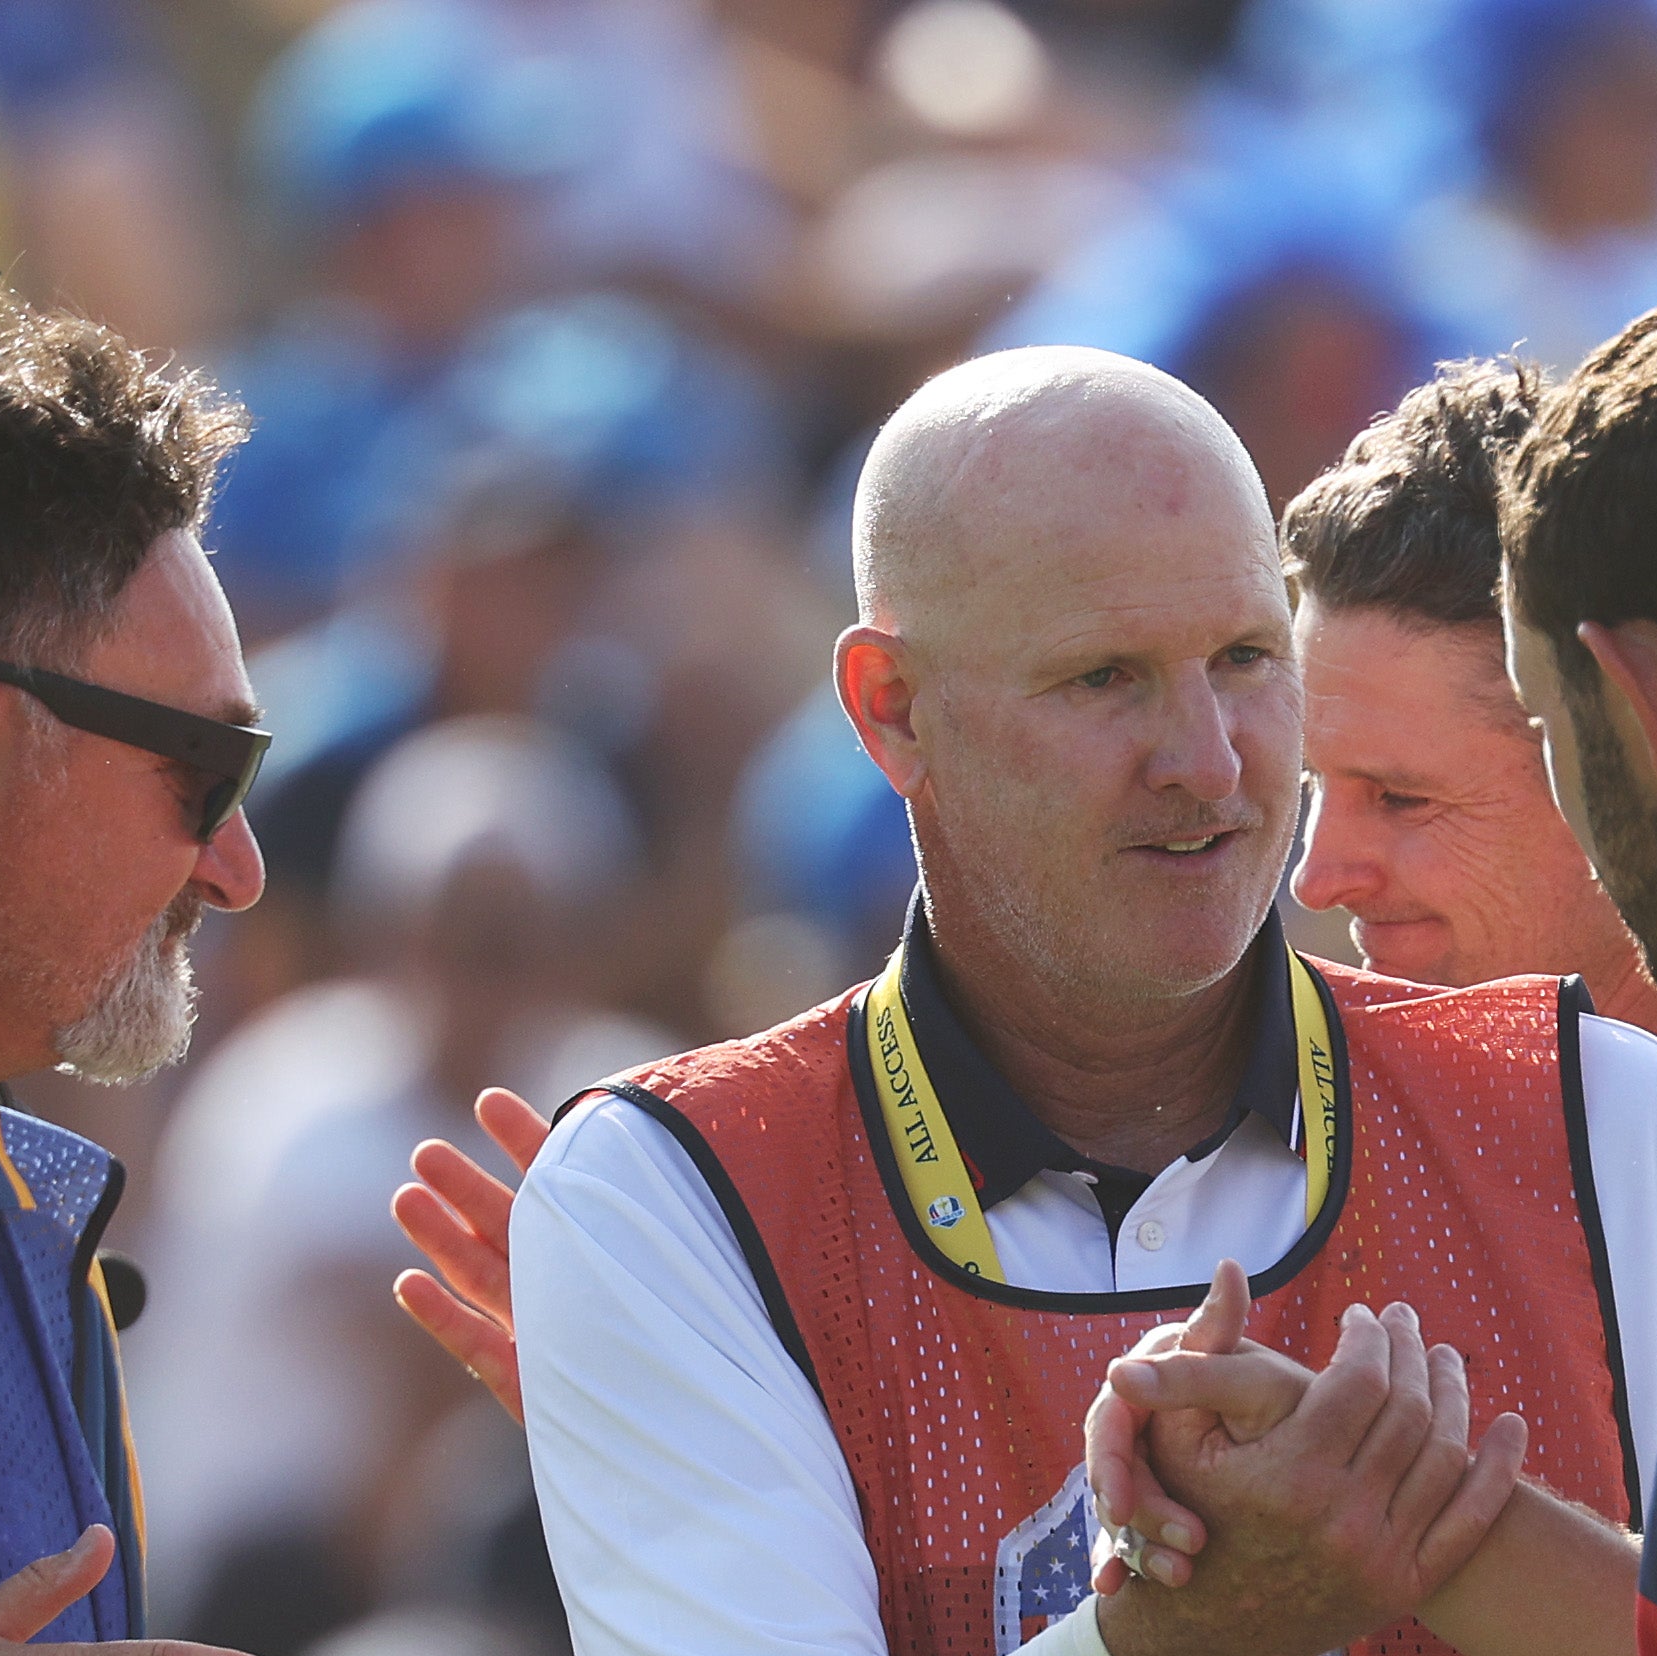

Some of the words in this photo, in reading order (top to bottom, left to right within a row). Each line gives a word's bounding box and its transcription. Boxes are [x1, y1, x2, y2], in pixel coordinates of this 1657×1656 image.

[877, 1006, 918, 1108] ACCESS
[1309, 1037, 1335, 1088] ALL
[905, 1110, 939, 1163] ALL
